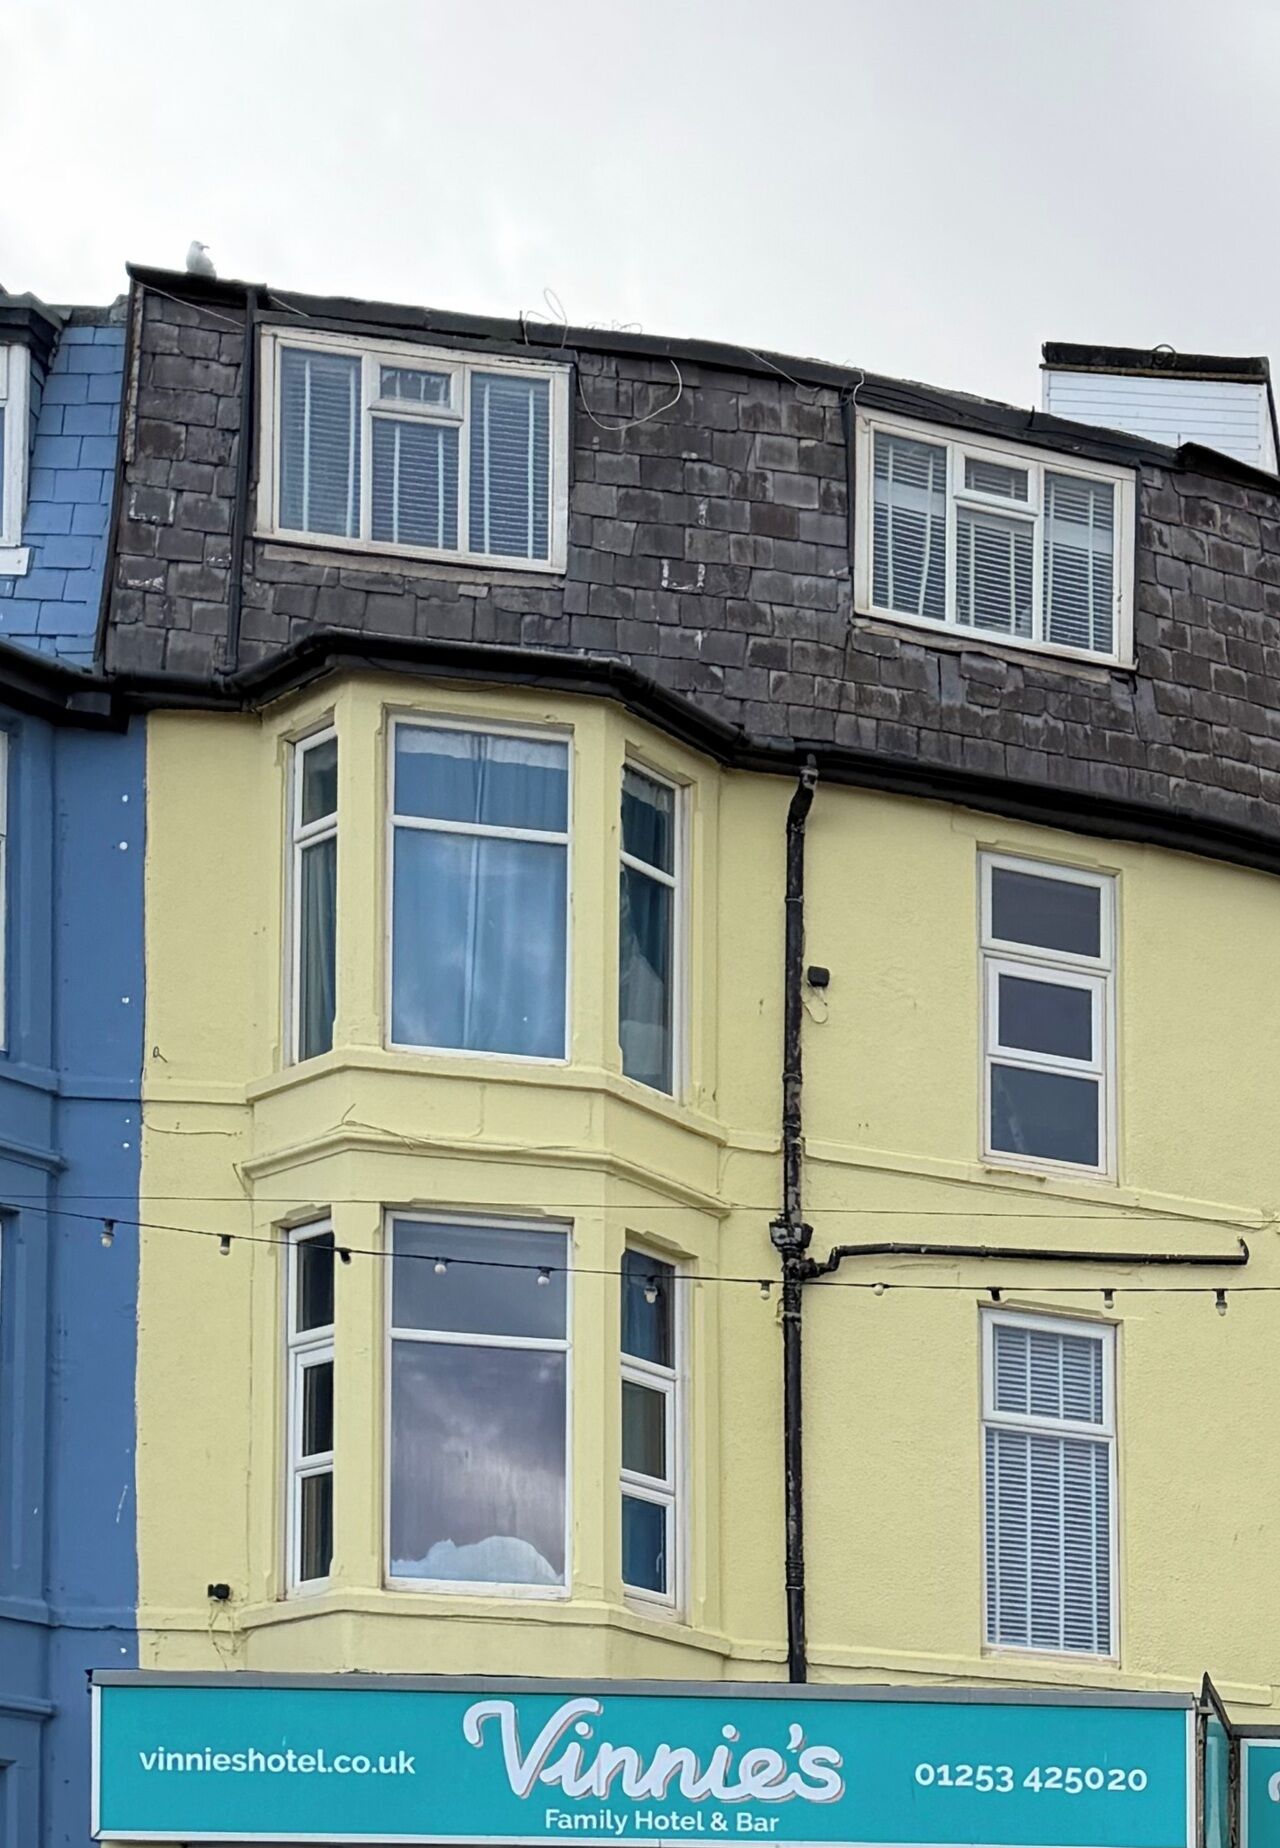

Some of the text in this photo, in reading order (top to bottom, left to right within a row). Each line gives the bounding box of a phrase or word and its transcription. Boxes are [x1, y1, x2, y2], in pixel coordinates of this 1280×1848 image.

[138, 1746, 416, 1775] vinnieshotel.co.uk
[462, 1697, 846, 1803] Vinnie's
[914, 1762, 1149, 1795] 01253 425020
[545, 1808, 780, 1836] Family Hotel & Bar
